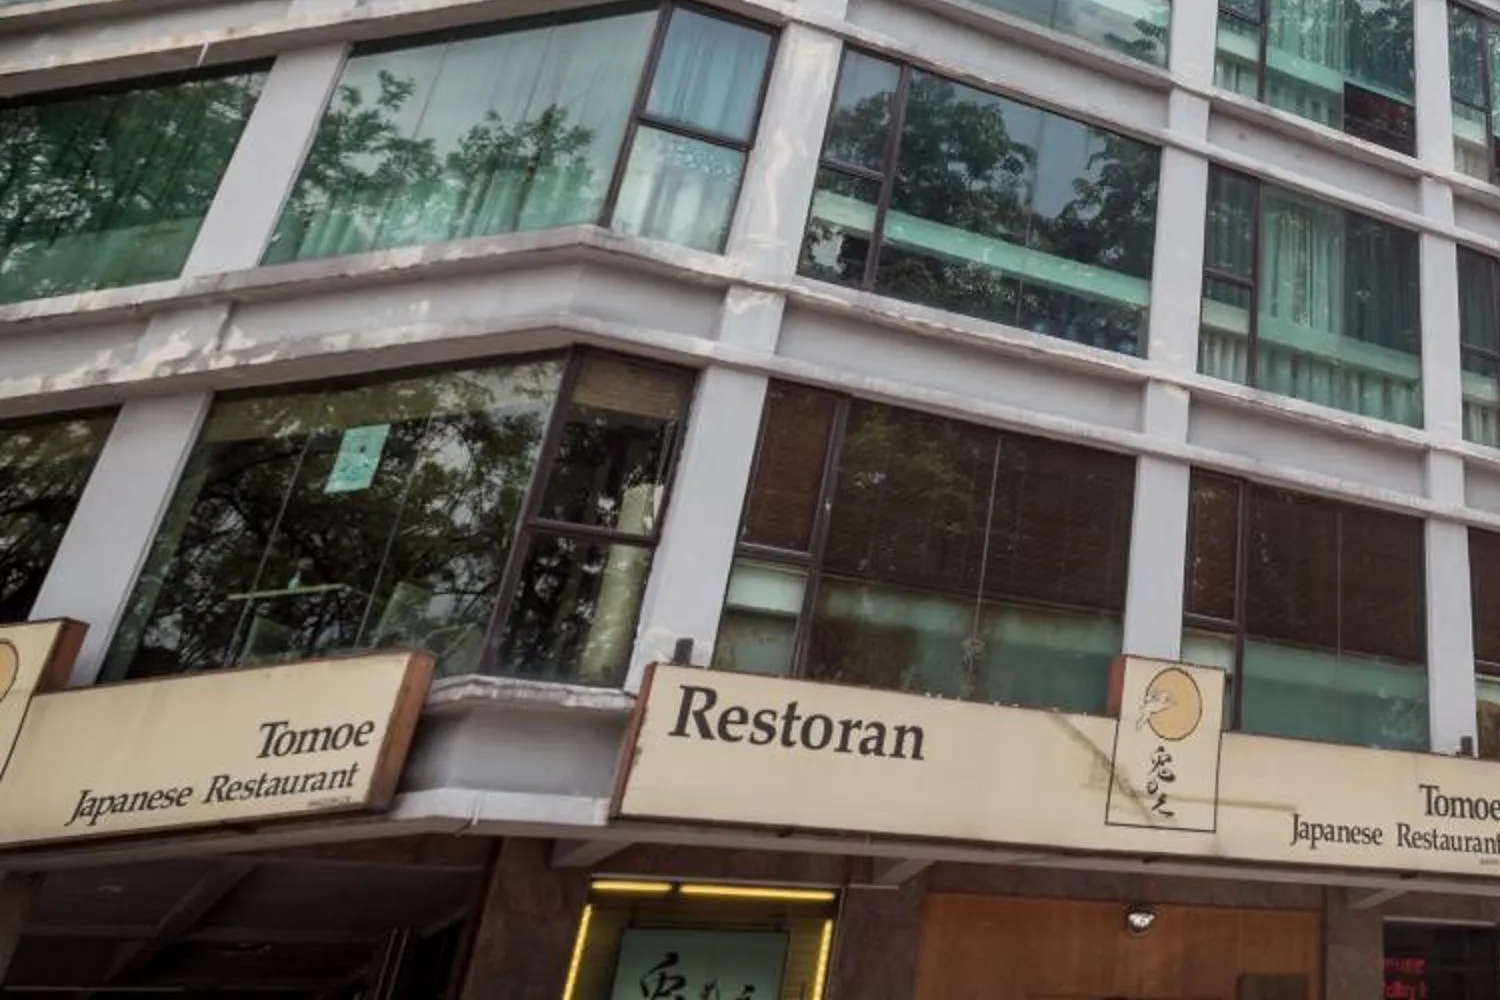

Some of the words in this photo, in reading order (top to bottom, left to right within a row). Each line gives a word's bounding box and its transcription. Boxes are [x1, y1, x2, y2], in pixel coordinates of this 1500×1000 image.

[257, 718, 375, 760] Tomoe
[668, 684, 925, 762] Restoran
[65, 785, 193, 827] Japanese
[201, 761, 360, 805] Restaurant
[1289, 813, 1384, 847] Japanese
